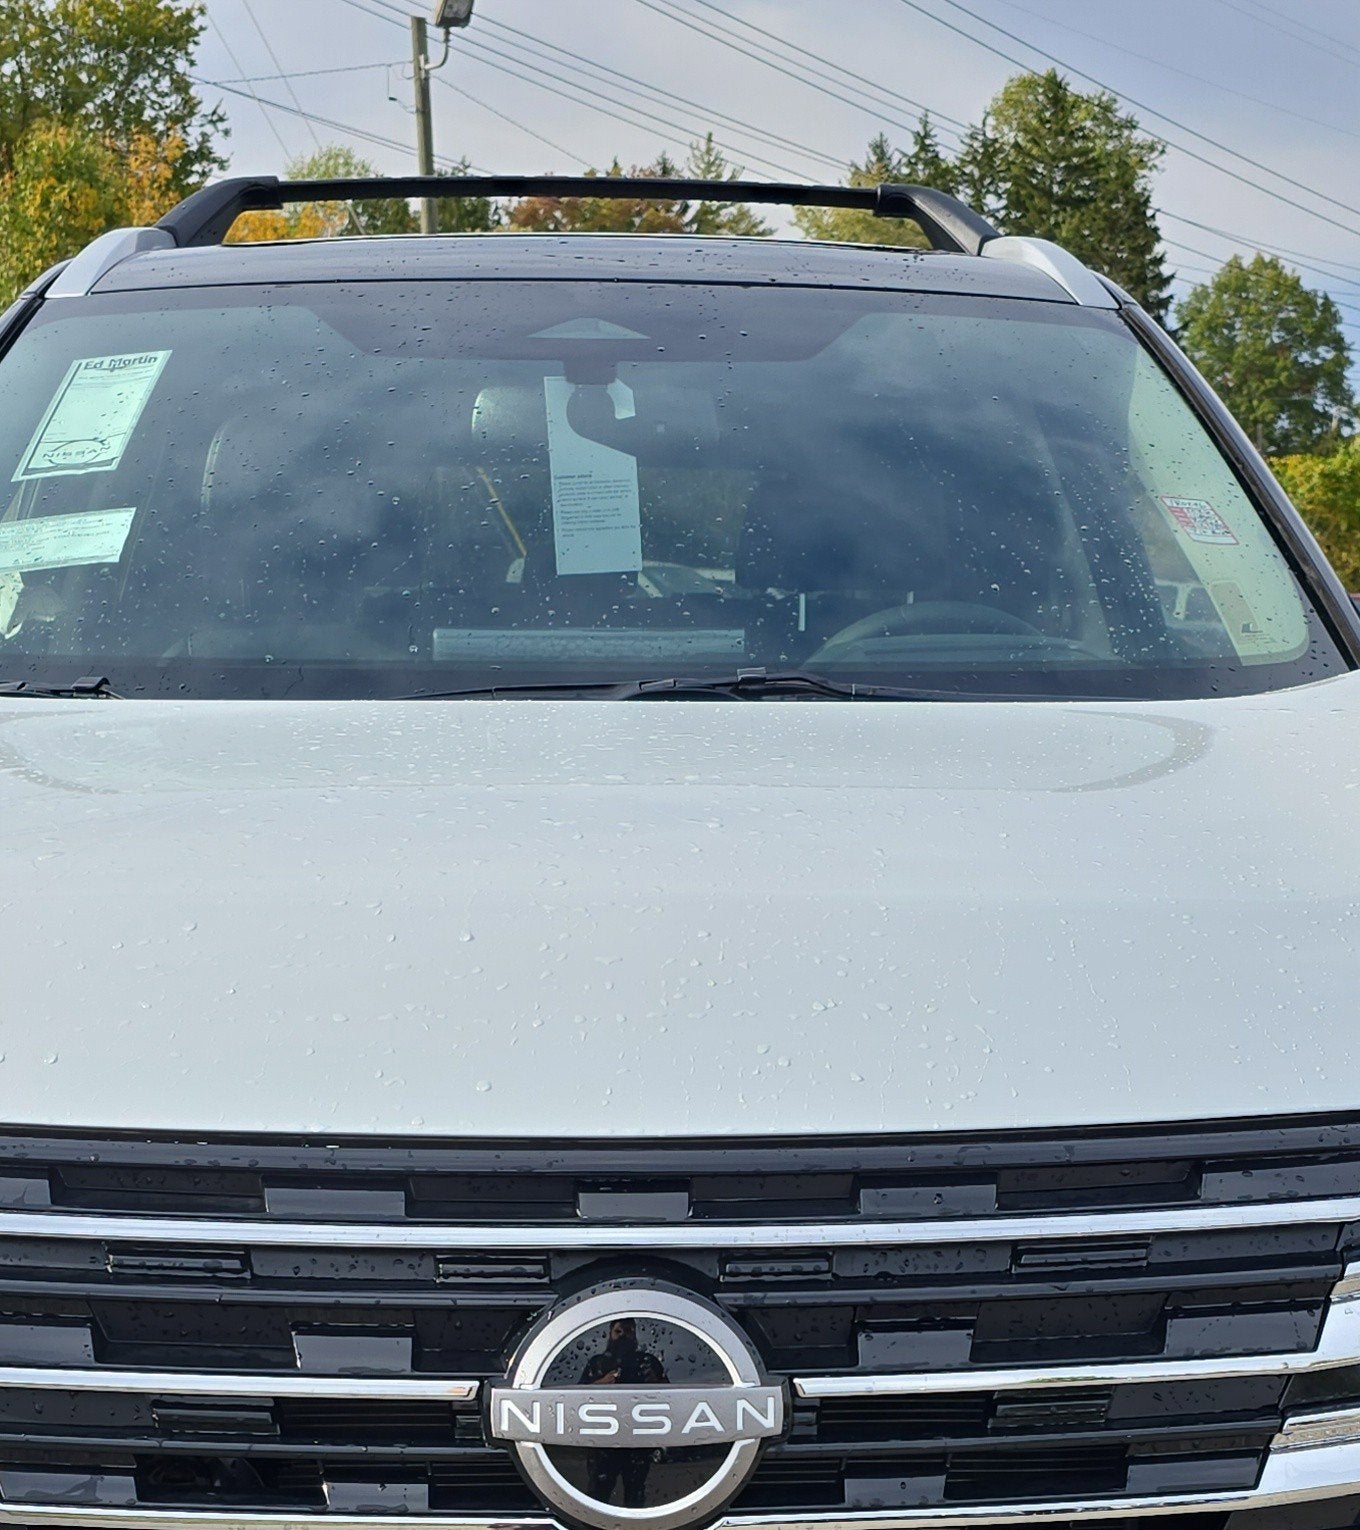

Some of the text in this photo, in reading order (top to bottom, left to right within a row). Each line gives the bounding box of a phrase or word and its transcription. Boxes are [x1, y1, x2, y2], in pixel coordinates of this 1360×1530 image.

[84, 355, 158, 370] Ed Martin
[43, 443, 111, 459] NISSAN
[500, 1396, 776, 1436] NISSAN
